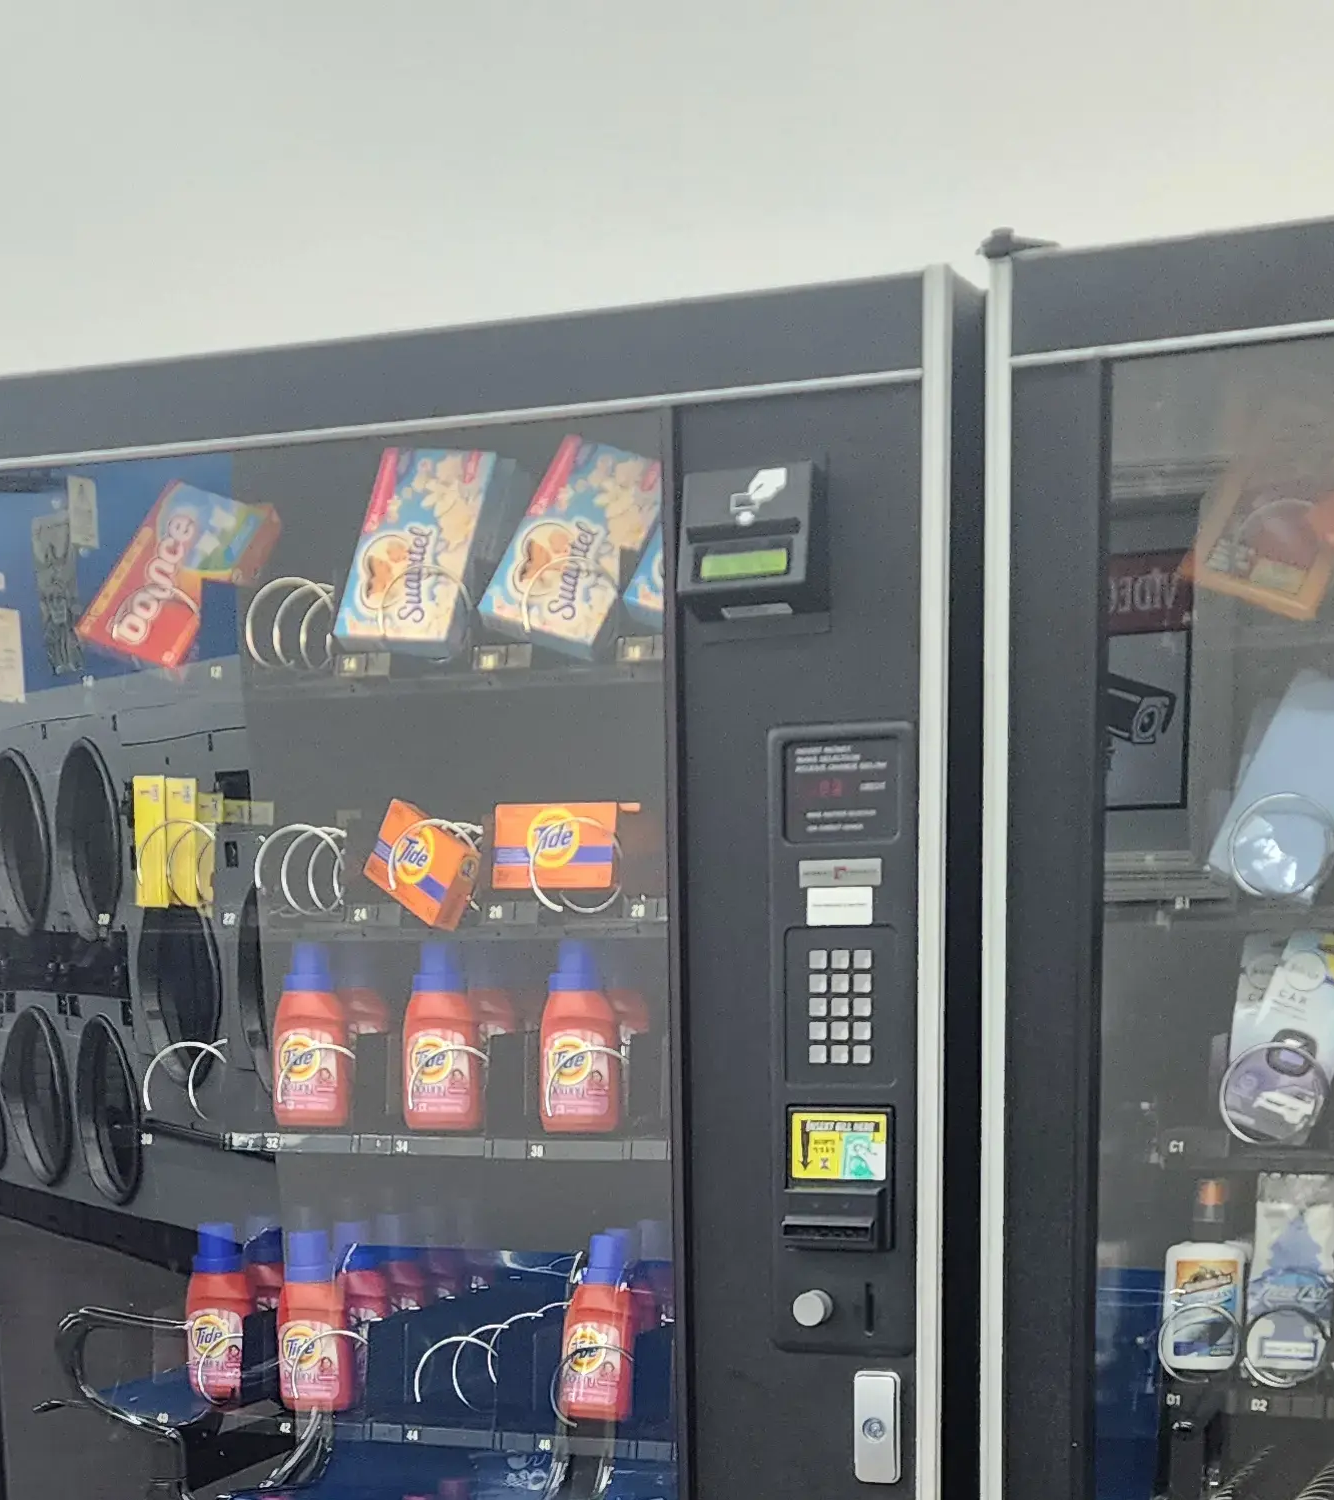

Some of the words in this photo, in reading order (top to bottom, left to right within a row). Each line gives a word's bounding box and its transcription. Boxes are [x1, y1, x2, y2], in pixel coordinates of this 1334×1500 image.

[533, 825, 574, 850] Tide
[397, 836, 429, 868] Tide
[279, 1422, 291, 1433] 42
